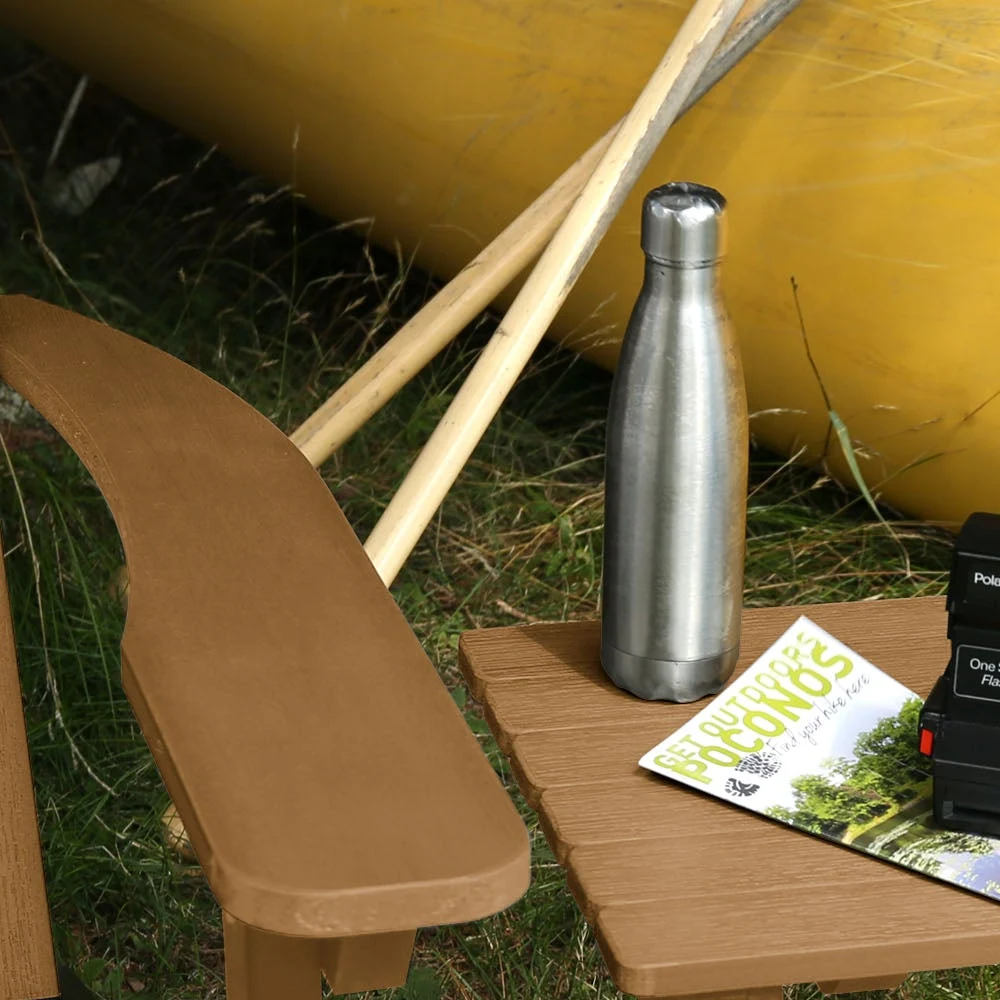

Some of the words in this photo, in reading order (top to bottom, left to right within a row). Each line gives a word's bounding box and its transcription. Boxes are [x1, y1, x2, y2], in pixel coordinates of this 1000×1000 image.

[653, 734, 702, 770] GET
[699, 631, 818, 737] OUTDOORS
[672, 640, 854, 785] POCONOS
[799, 716, 823, 746] your
[813, 694, 847, 721] hike
[834, 674, 870, 700] here
[969, 658, 996, 673] One
